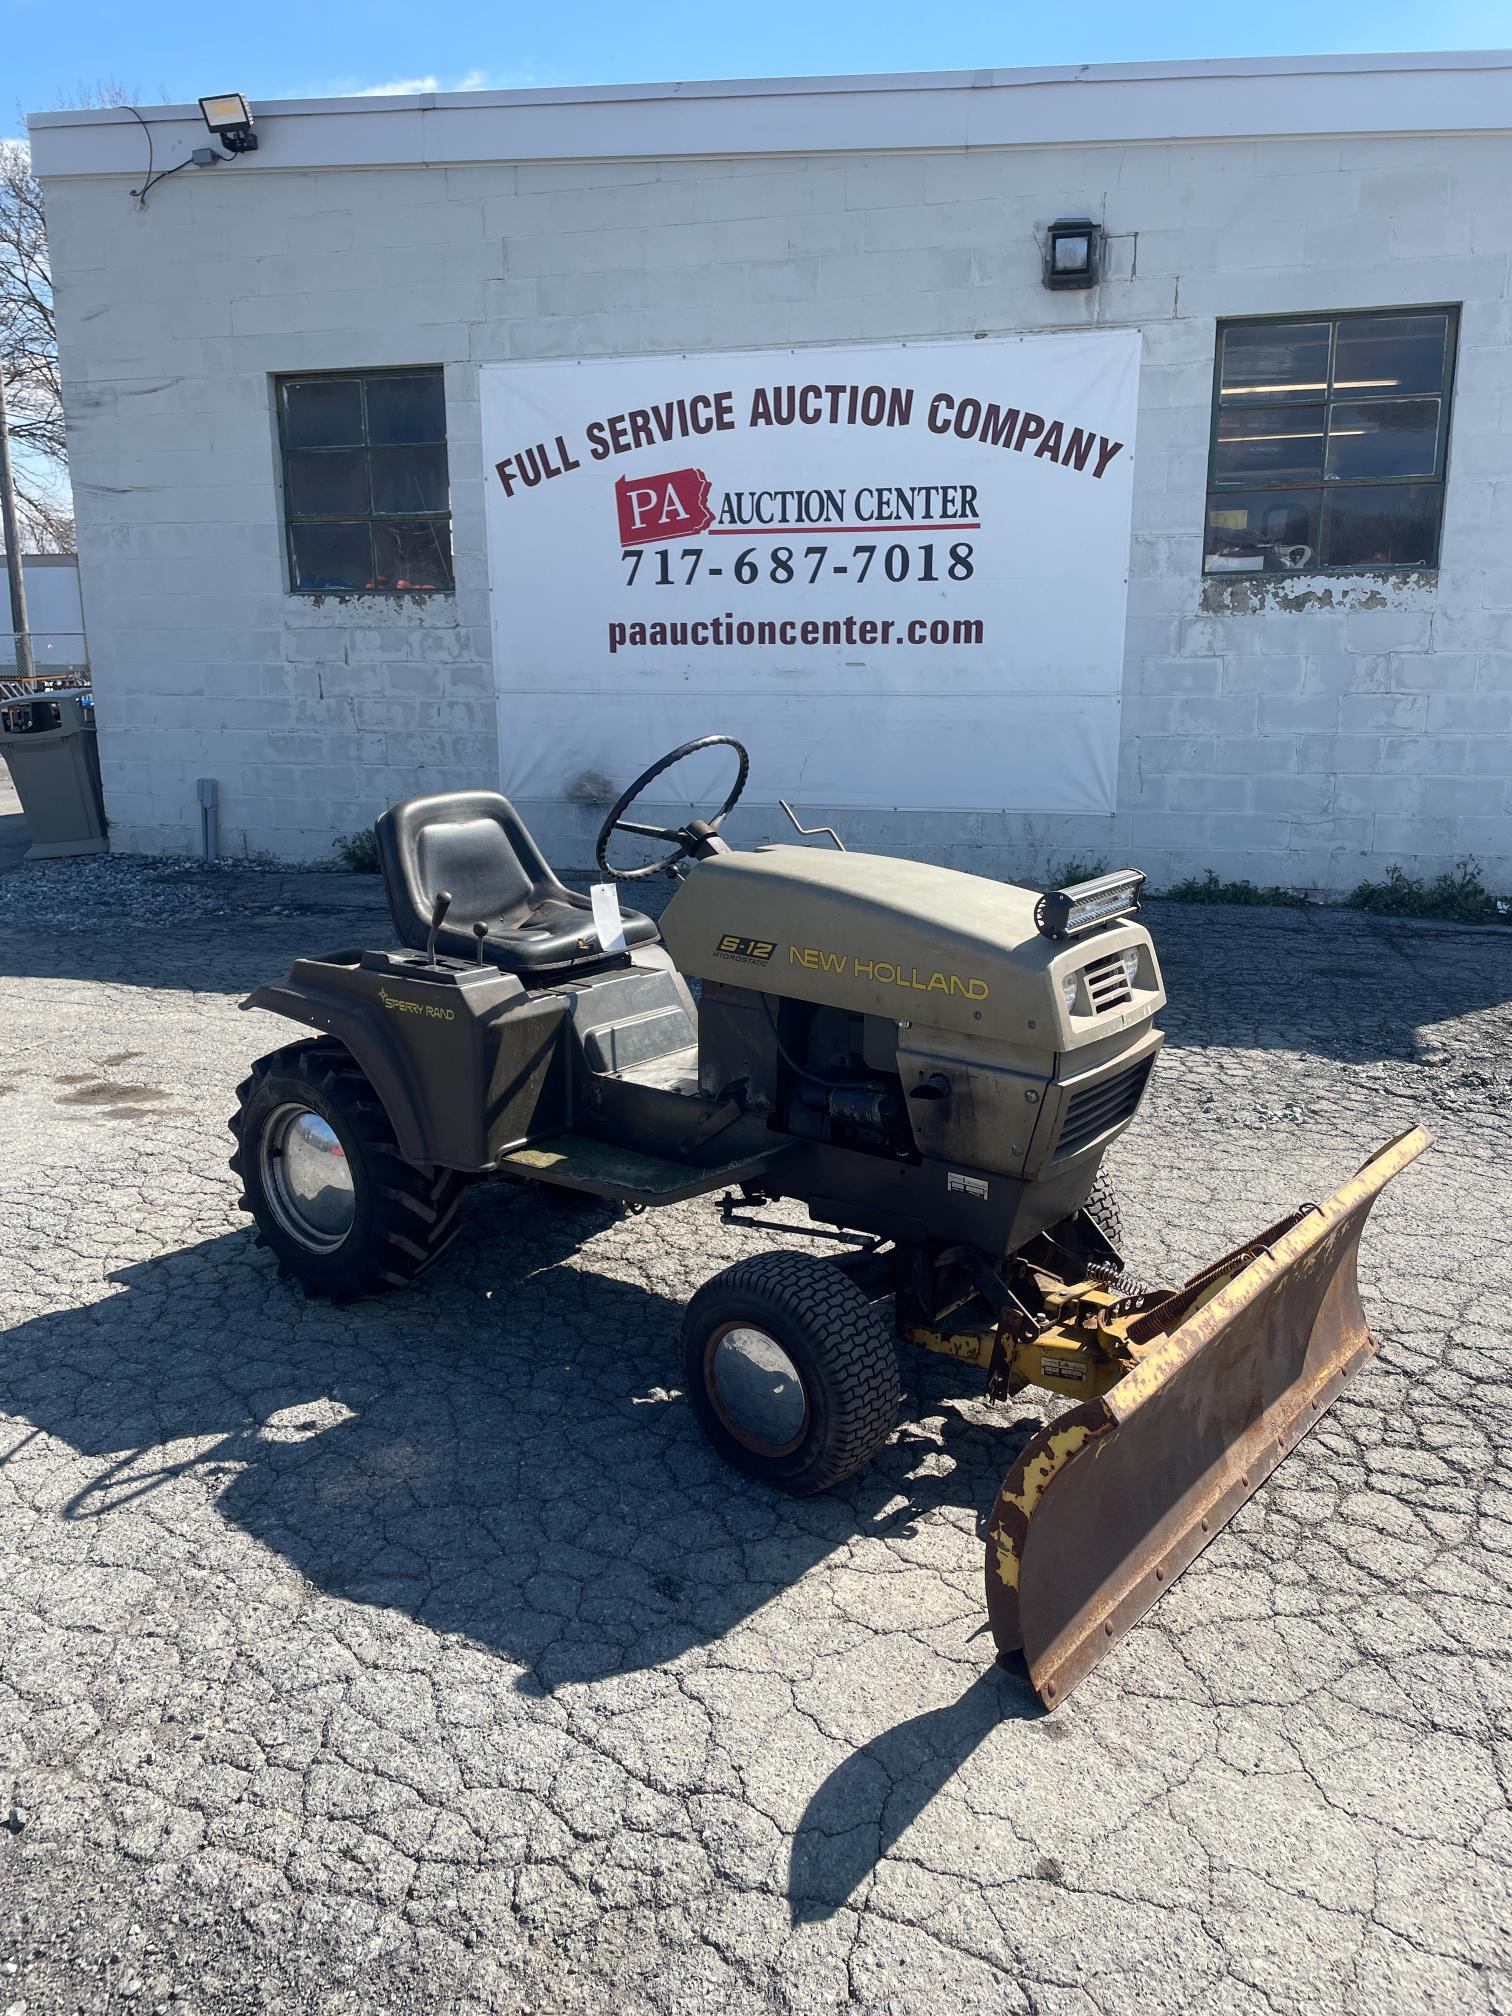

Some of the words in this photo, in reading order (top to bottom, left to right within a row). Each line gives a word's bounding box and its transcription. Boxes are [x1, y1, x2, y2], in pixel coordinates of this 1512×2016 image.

[495, 436, 581, 497] FULL
[586, 391, 735, 461] SERVICE
[749, 384, 914, 428] AUCTION
[927, 393, 1124, 480] COMPANY
[626, 483, 690, 529] PA
[718, 490, 847, 525] AUCTION
[854, 484, 980, 522] CENTER
[621, 542, 975, 586] 717-687-7018
[608, 612, 985, 654] paauctioncenter.com
[712, 951, 769, 967] HYDROSTATIC
[719, 935, 774, 958] S-12
[789, 945, 847, 975] NEW
[854, 958, 990, 1000] HOLLAND
[385, 998, 424, 1015] SPERRY
[425, 1005, 455, 1020] RAND
